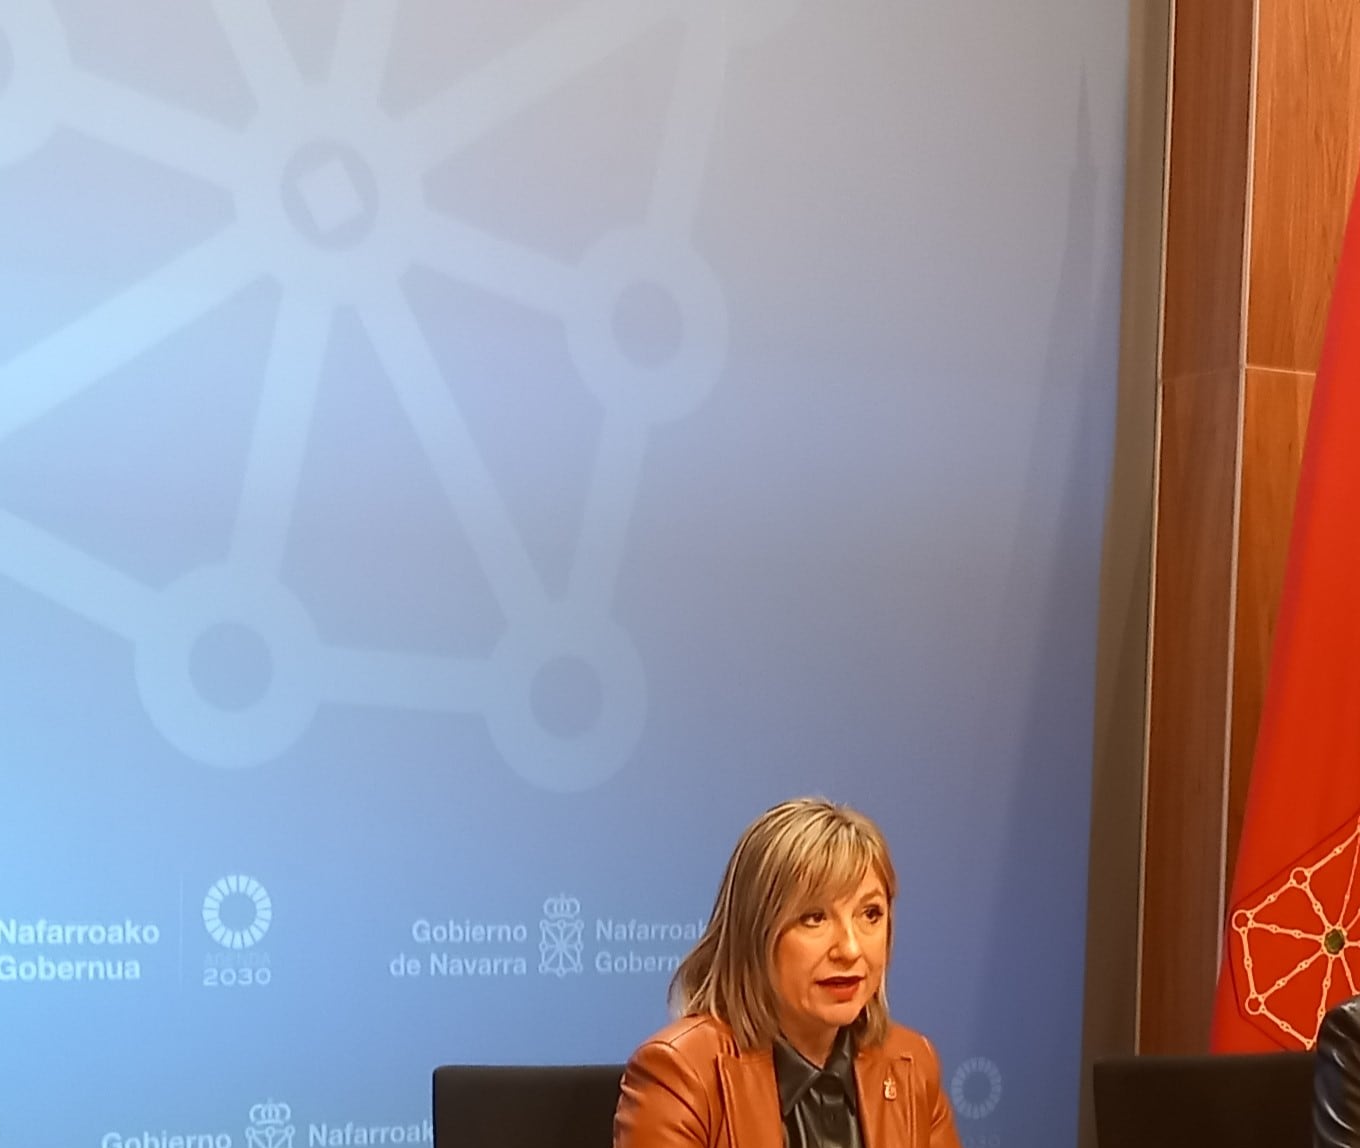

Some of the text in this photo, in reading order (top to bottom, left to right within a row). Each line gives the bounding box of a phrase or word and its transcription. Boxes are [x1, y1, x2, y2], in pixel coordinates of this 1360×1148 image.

[412, 918, 528, 944] Gobierno
[595, 918, 708, 942] Nafarroak
[390, 952, 528, 977] de Navarra
[594, 951, 681, 974] Gobern
[202, 967, 272, 987] 2030
[308, 1119, 434, 1148] Nafarroak
